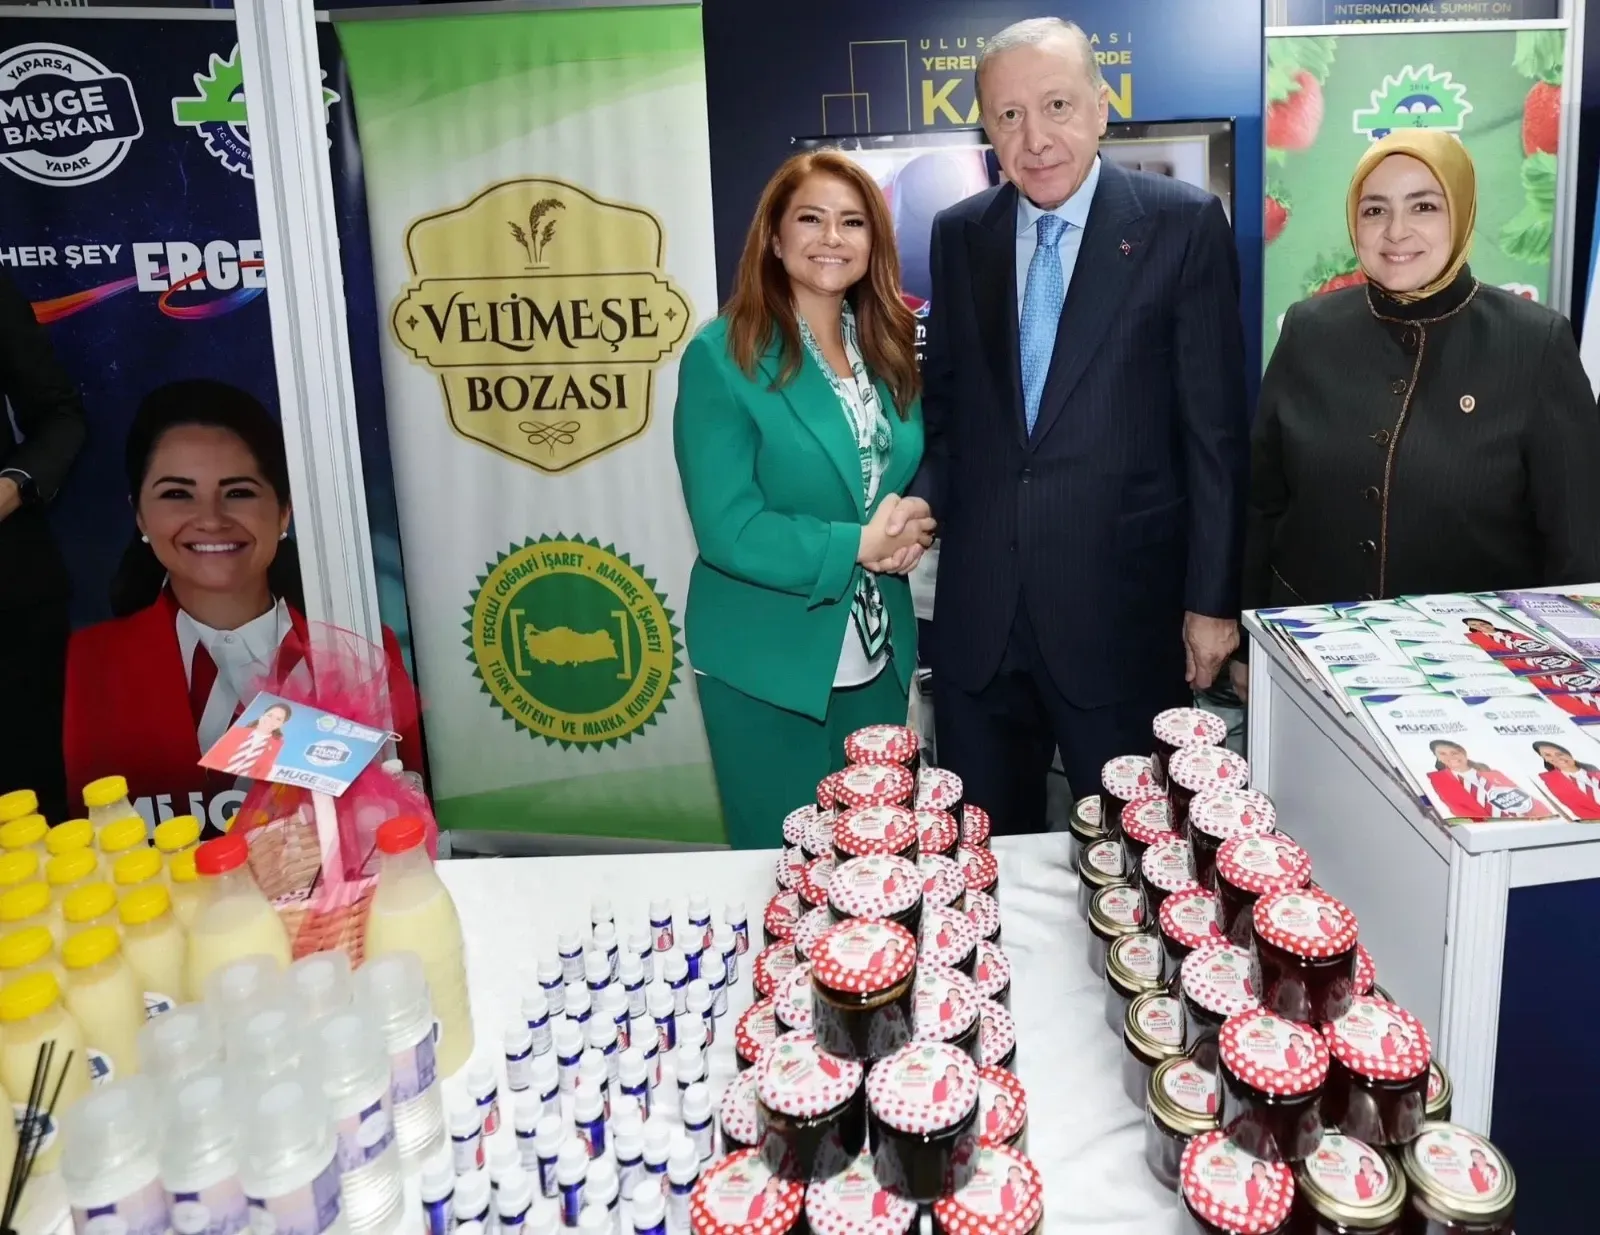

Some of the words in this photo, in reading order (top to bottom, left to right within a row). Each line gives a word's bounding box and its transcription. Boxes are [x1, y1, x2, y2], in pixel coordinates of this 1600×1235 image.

[1334, 3, 1437, 15] INTERNATIONAL
[1440, 2, 1488, 14] SUMMIT
[1492, 2, 1512, 13] ON
[7, 57, 73, 81] YAPARSA
[0, 86, 109, 124] MÜGE
[3, 114, 115, 146] BAŞKAN
[45, 156, 92, 173] YAPAR
[0, 246, 57, 267] HER
[65, 244, 122, 269] ŞEY
[420, 291, 659, 353] VELİMEŞE
[465, 373, 629, 412] BOZASI
[483, 595, 502, 648] TESCİLLİ
[495, 554, 539, 597] COĞRAFİ
[540, 551, 584, 571] İŞARET
[595, 561, 644, 608] MAHREÇ
[636, 604, 665, 654] İŞARETİ
[487, 659, 516, 695] TÜRK
[511, 694, 556, 729] PATENT
[561, 719, 577, 736] VE
[582, 713, 627, 736] MARKA
[624, 666, 663, 720] KURUMU
